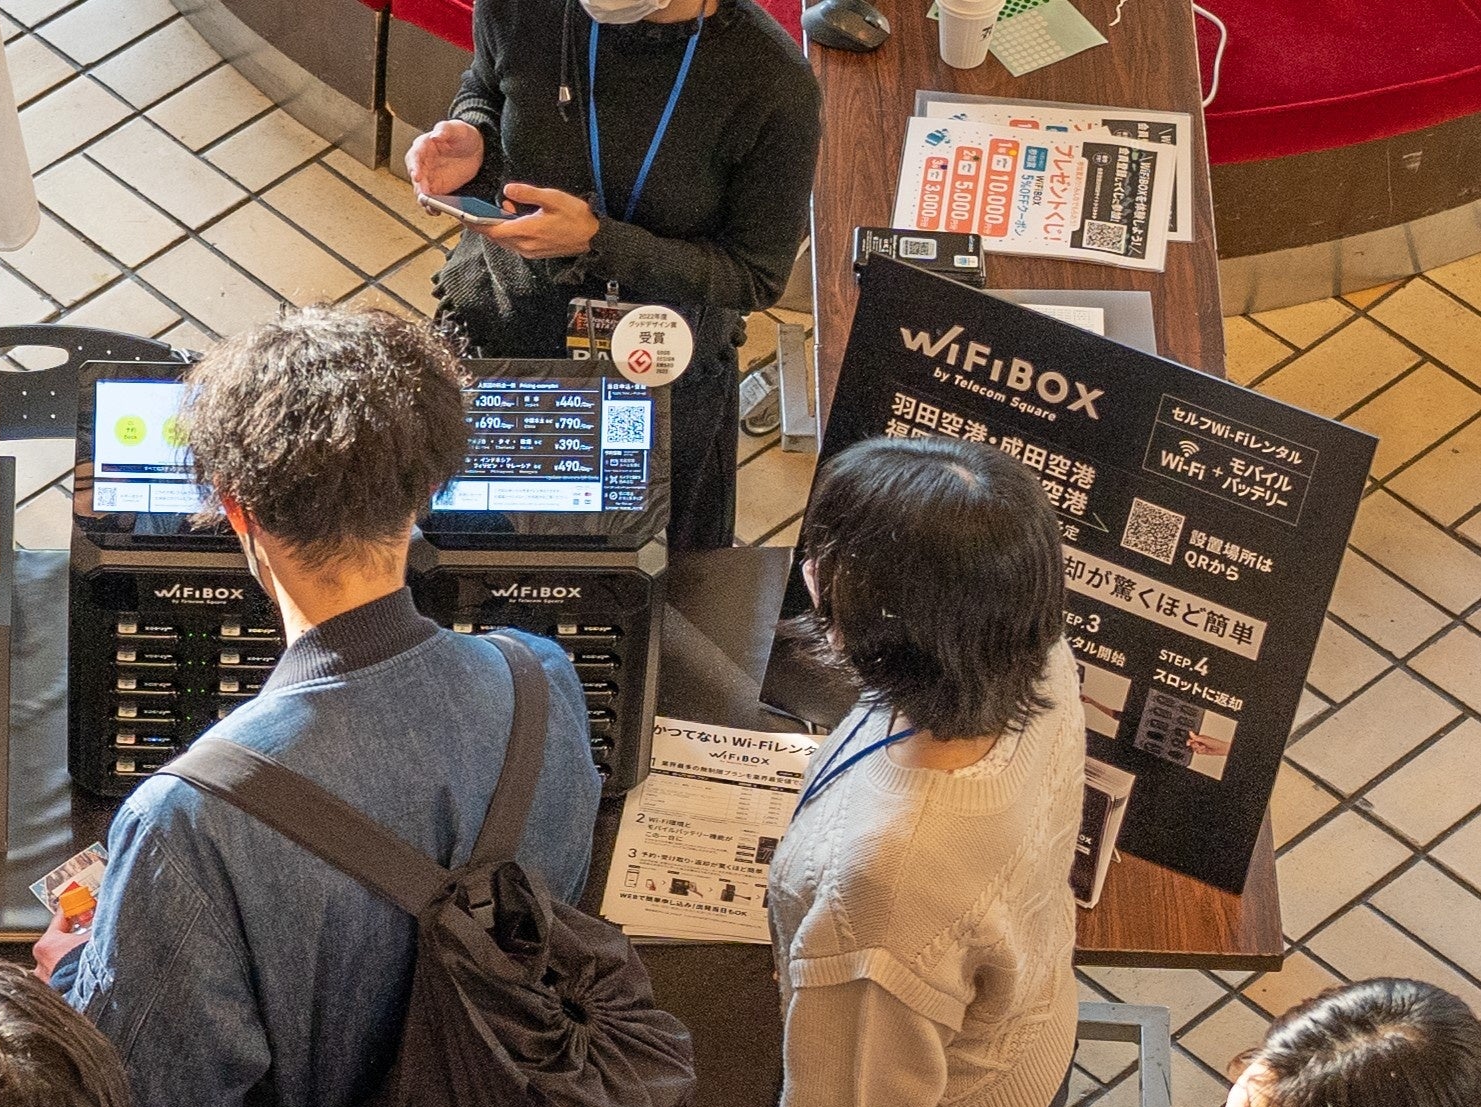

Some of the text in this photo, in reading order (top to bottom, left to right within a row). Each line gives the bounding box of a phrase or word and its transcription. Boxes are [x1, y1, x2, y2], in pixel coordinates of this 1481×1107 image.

[1043, 145, 1074, 241] プレゼントくじ!
[639, 331, 666, 344] 受賞
[933, 366, 1057, 422] by Telecom Square
[1171, 406, 1303, 466] セルフWi-Fiレンタル
[1160, 449, 1206, 481] Wi-Fi
[1229, 457, 1293, 493] モバイル
[1222, 476, 1288, 510] バッテリー
[1184, 550, 1240, 582] QRから
[1189, 528, 1275, 574] 設置場所は
[1067, 636, 1127, 667] タル開始
[1159, 649, 1210, 676] STEP.4
[1153, 668, 1244, 713] スロットに返却
[653, 723, 728, 745] かつてない
[635, 813, 645, 824] 2
[627, 848, 637, 858] 3
